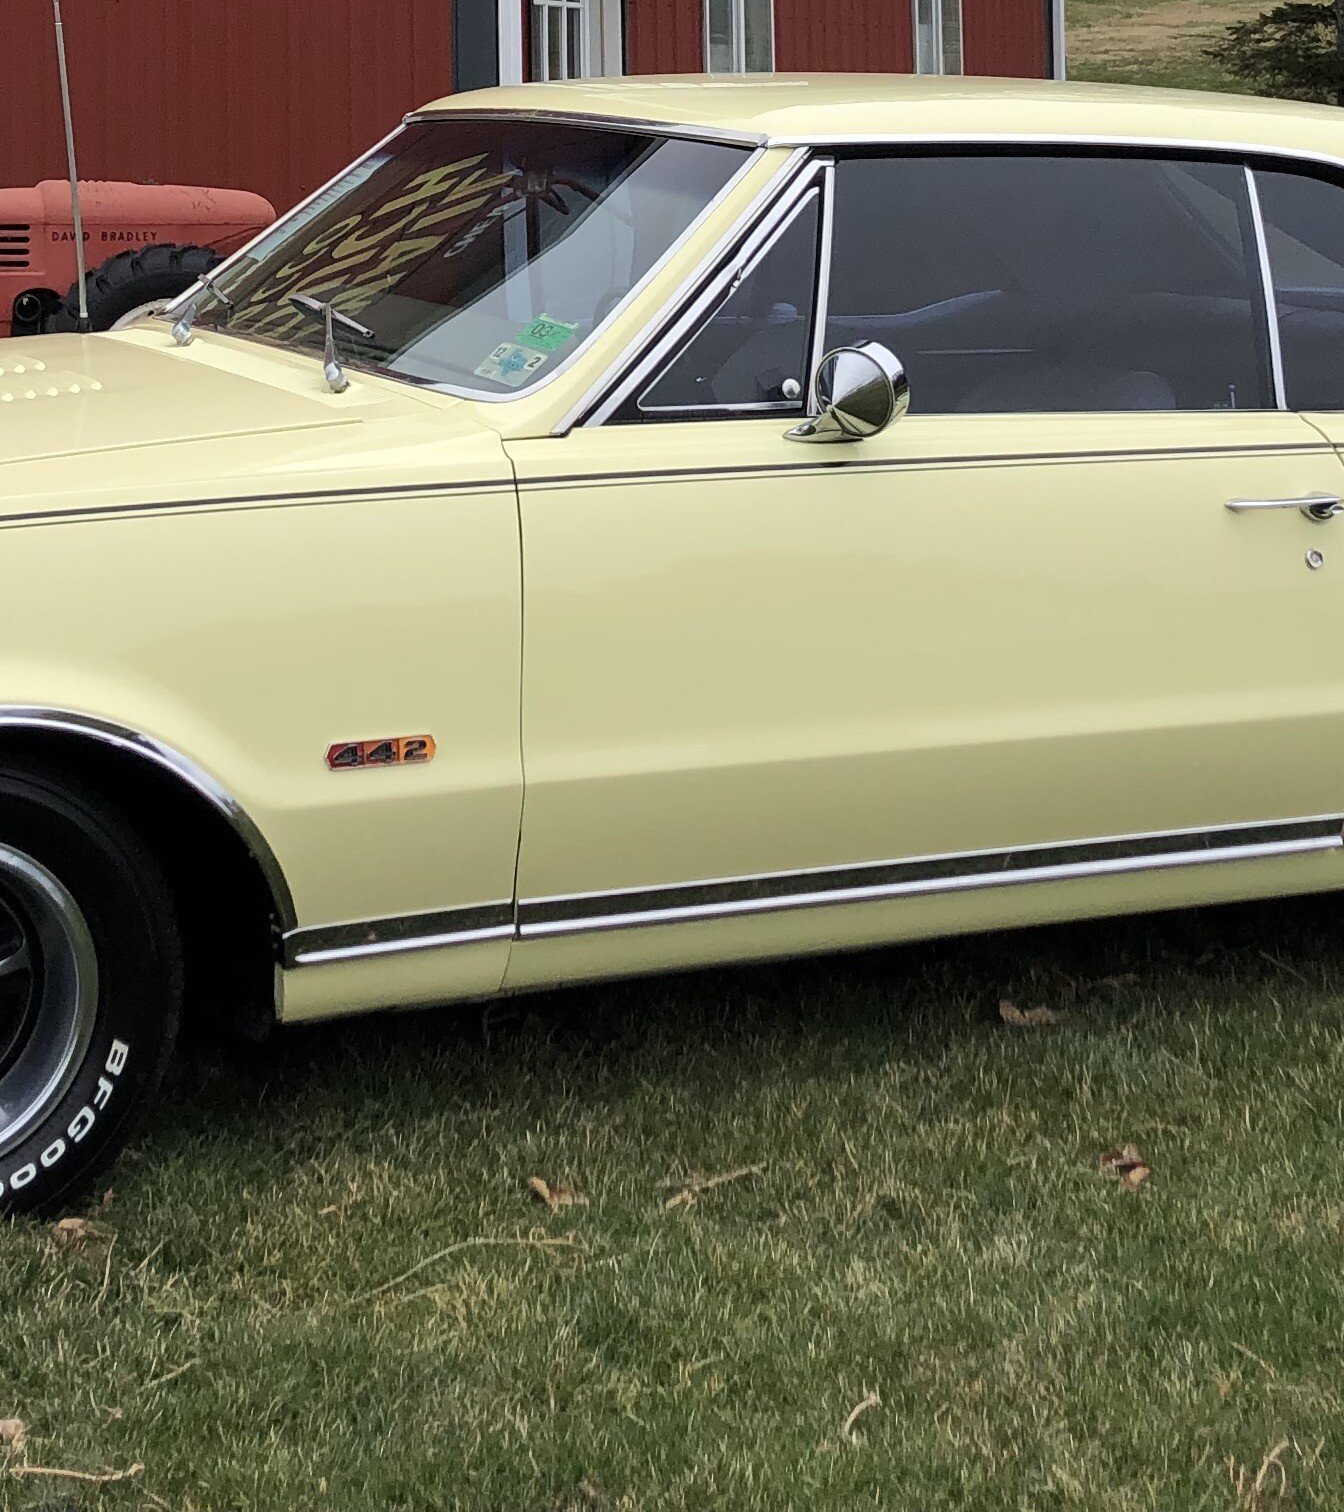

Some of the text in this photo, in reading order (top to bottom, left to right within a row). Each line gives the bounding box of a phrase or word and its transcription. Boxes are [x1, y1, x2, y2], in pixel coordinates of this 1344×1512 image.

[51, 231, 158, 242] DAVD BRADLEY
[333, 739, 428, 768] 442
